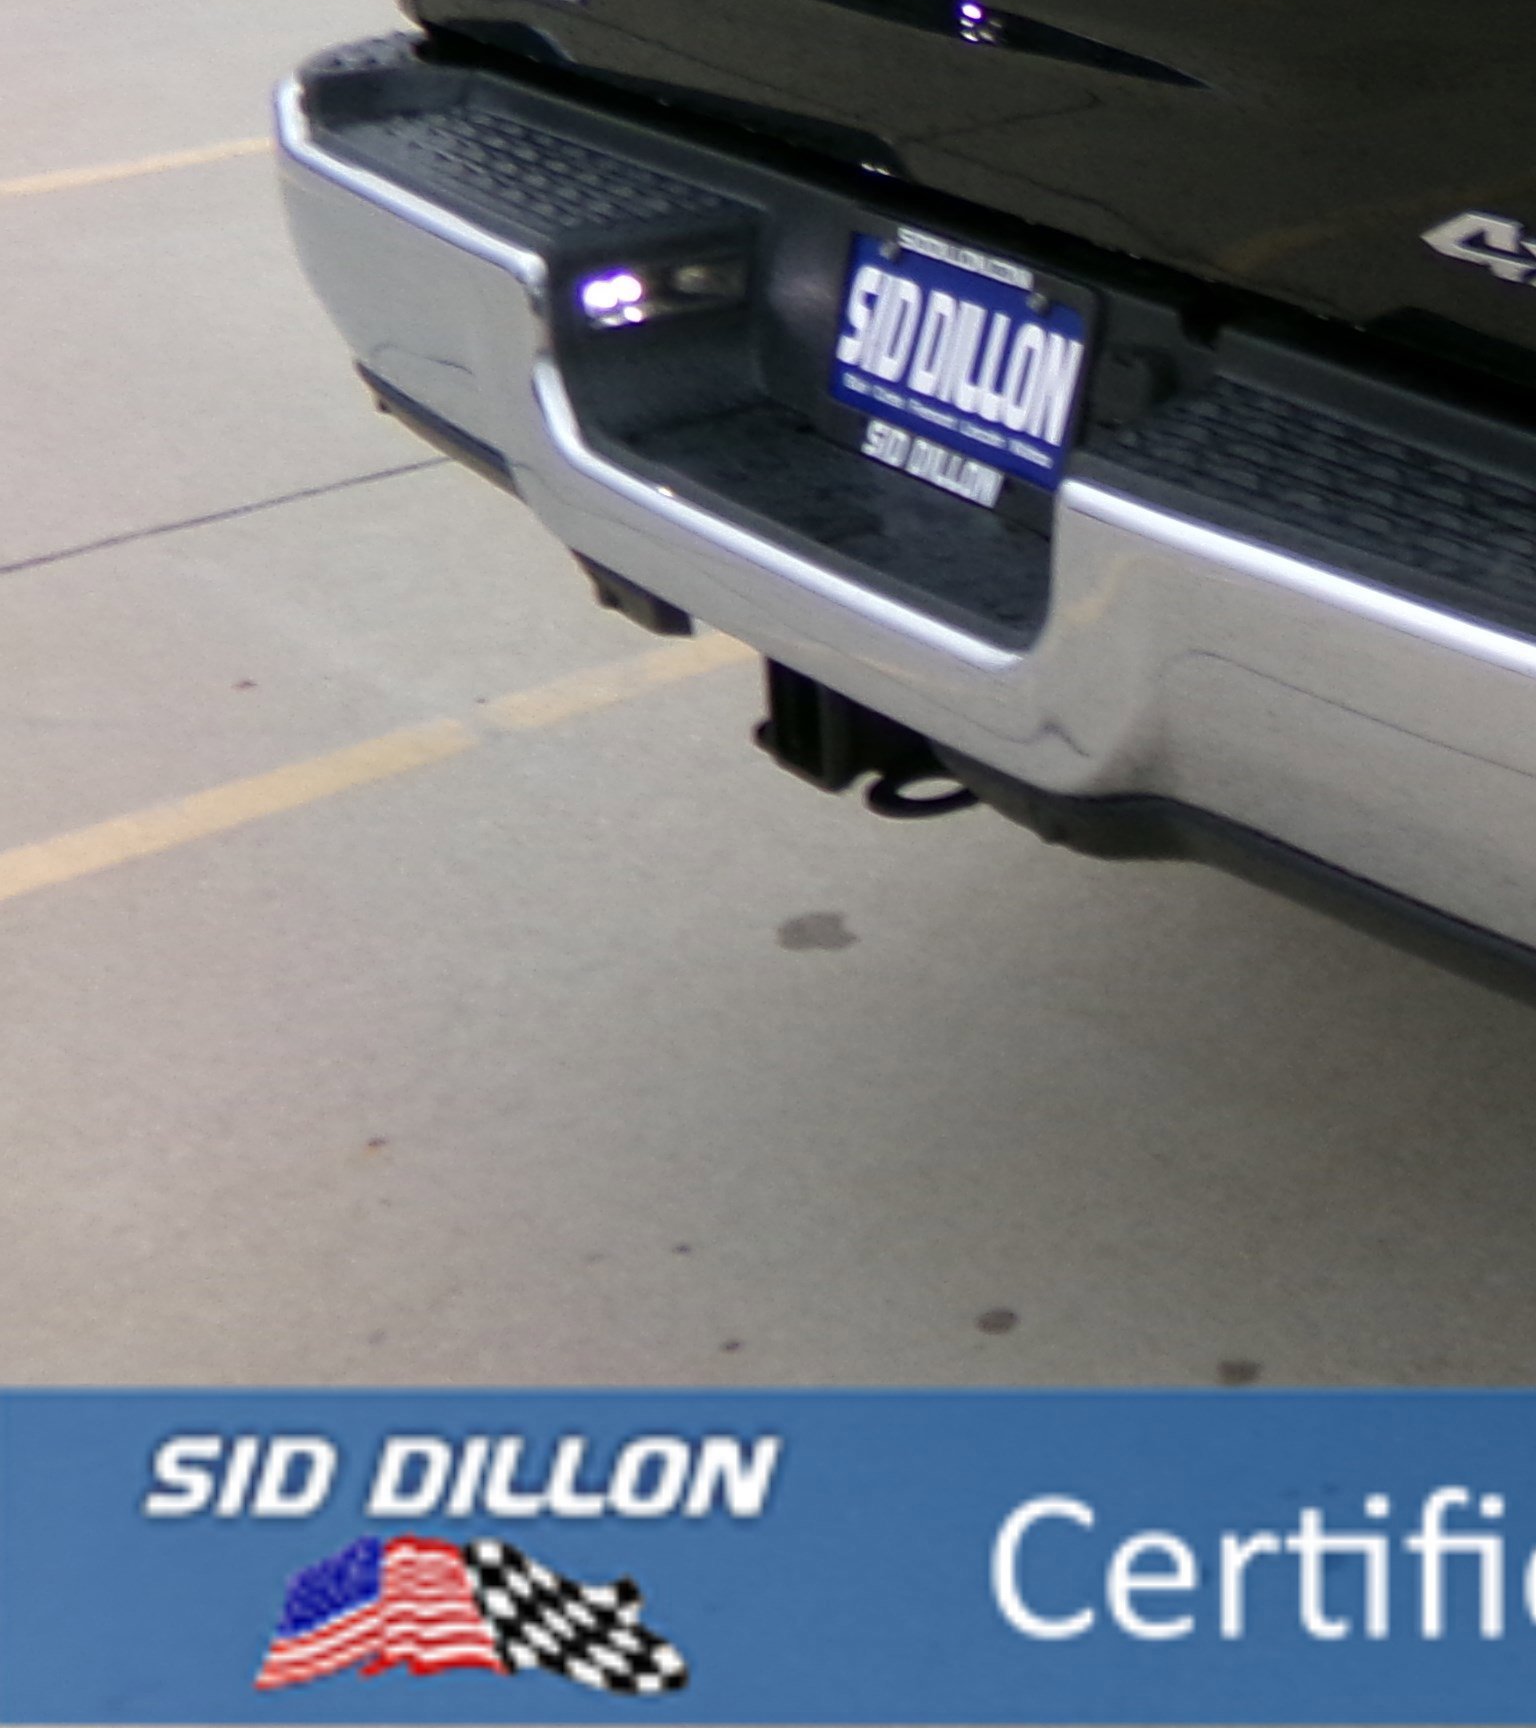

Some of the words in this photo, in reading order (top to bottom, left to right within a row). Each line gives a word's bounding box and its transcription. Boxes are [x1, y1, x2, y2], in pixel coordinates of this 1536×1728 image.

[835, 265, 922, 383] SID
[907, 289, 1084, 448] DILLON
[860, 420, 911, 469] SID
[904, 436, 1004, 509] DILLON
